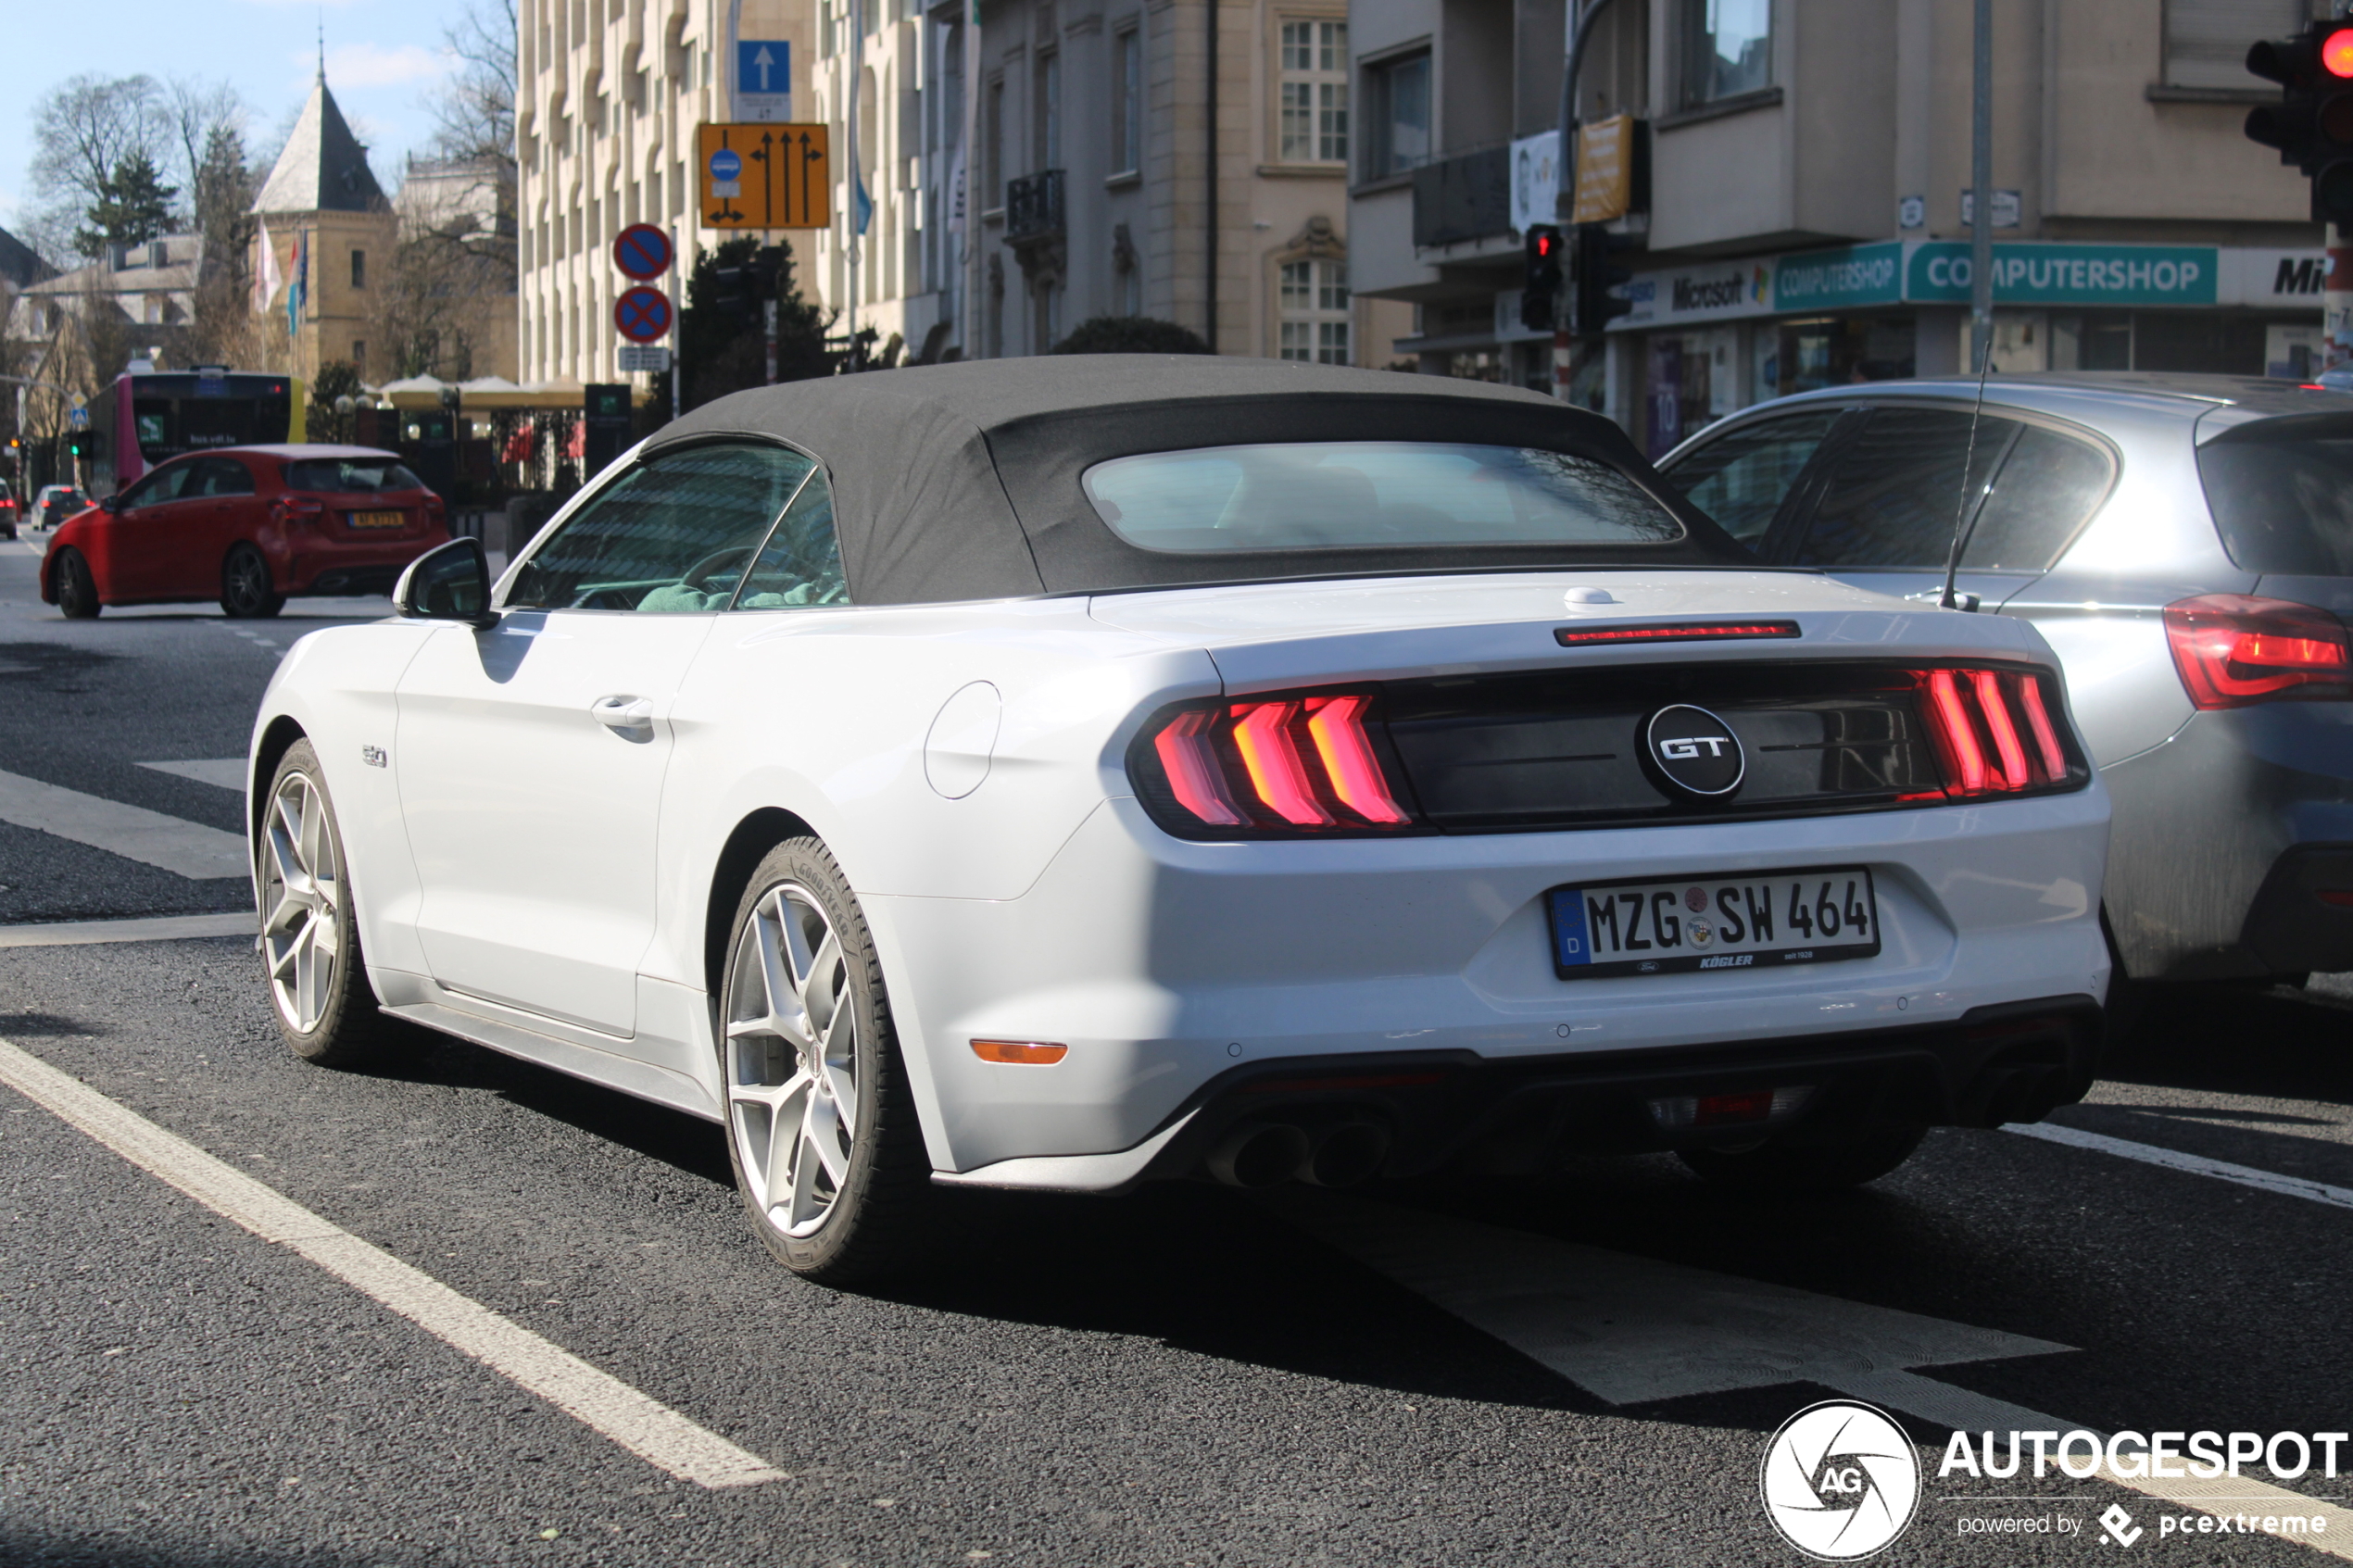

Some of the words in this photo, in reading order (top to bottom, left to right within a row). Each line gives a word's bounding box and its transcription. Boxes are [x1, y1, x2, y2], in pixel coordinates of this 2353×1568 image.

[1672, 271, 1743, 312] Microsoft
[1780, 257, 1895, 297] COMPUTERSHOP
[2273, 257, 2326, 295] Mi
[1659, 736, 1730, 760] GT
[799, 862, 849, 937] GOODYEAR
[1587, 891, 1681, 953] MZG
[1716, 885, 1774, 943] SW
[1789, 881, 1868, 939] 464
[1567, 937, 1579, 954] D
[1699, 954, 1754, 969] KÖGLER
[1797, 950, 1813, 960] 1928
